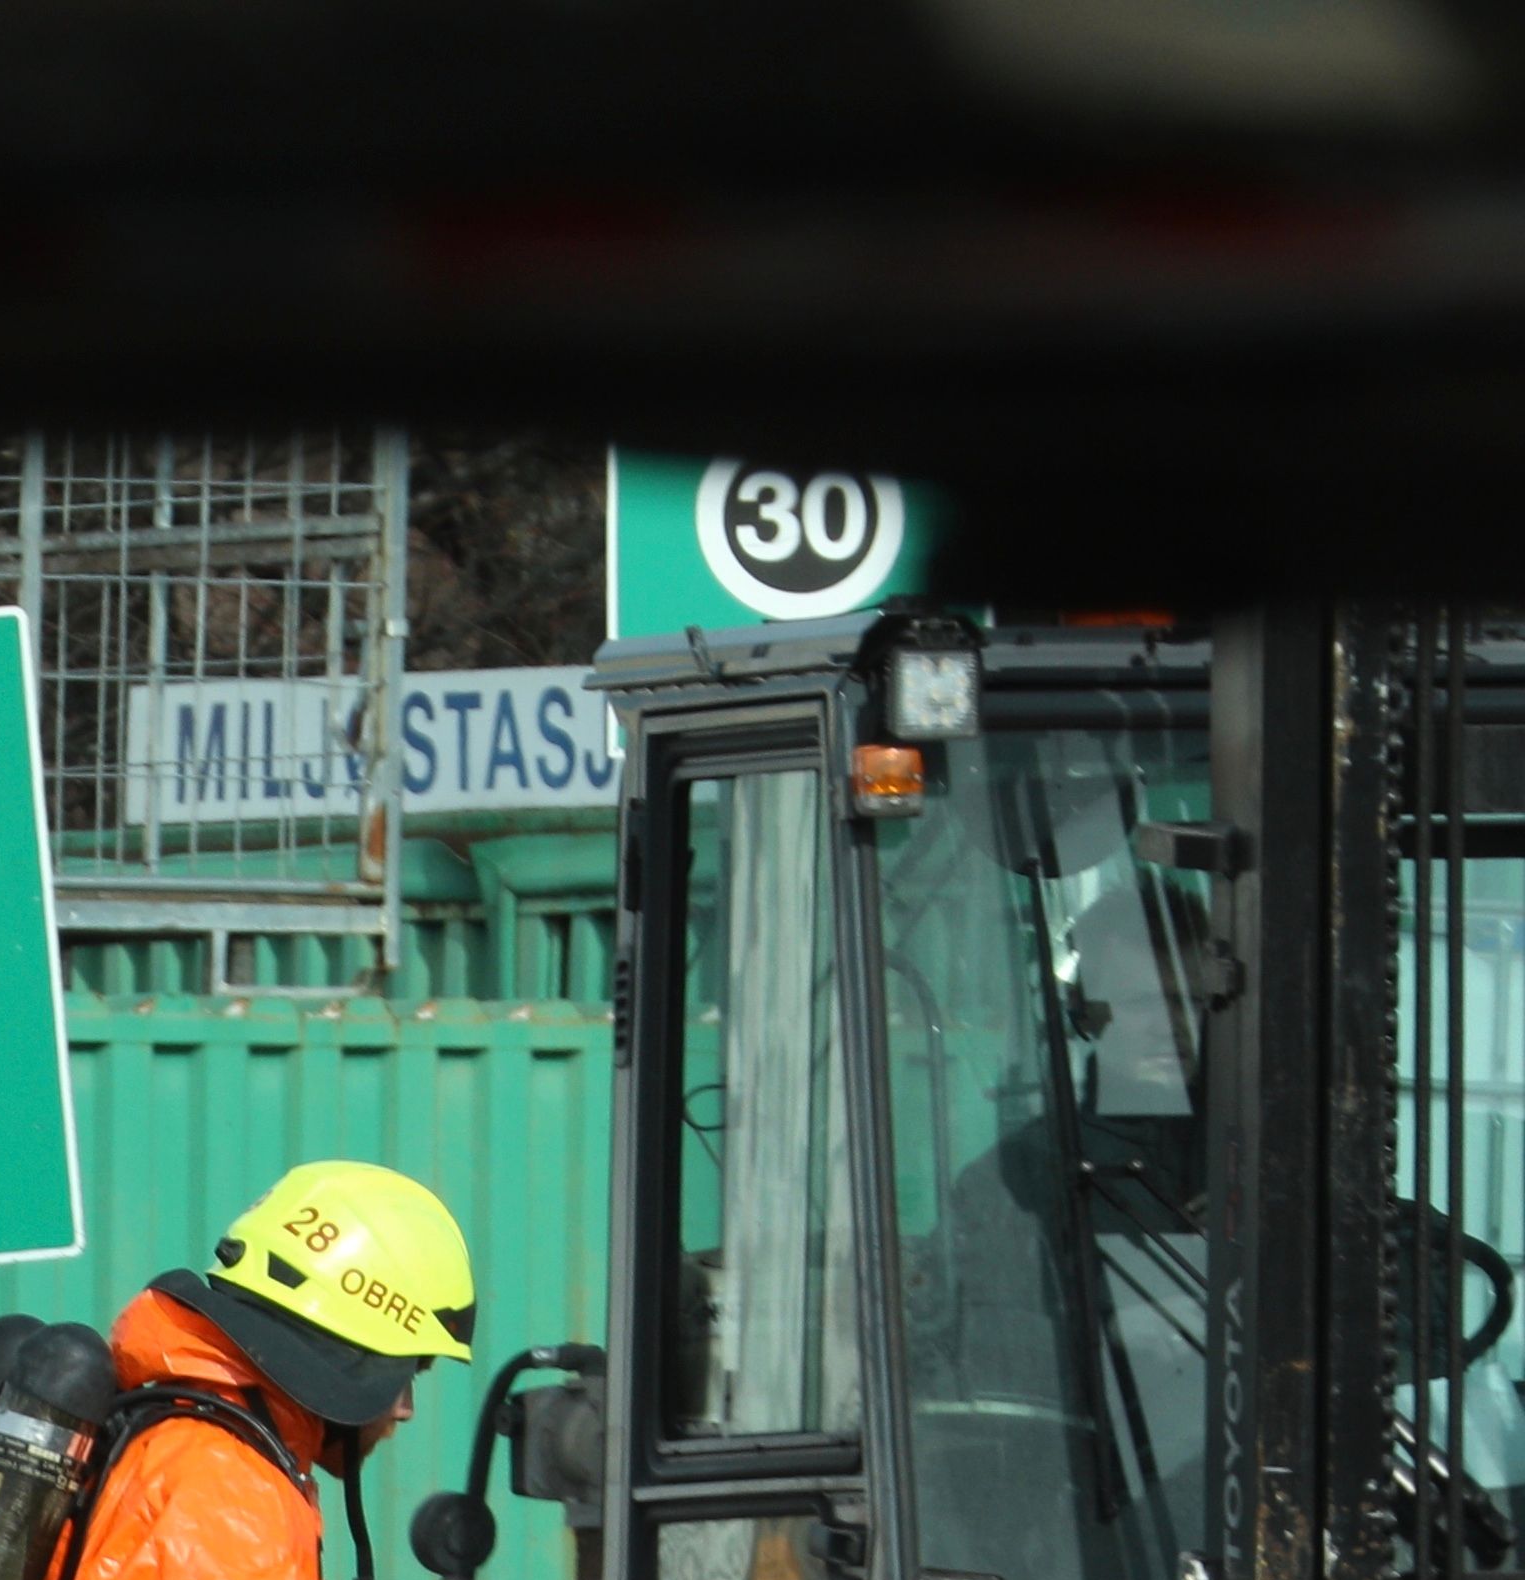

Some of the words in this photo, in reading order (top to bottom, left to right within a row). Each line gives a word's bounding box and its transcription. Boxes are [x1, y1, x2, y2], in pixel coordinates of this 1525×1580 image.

[735, 469, 868, 562] 30
[282, 1206, 340, 1253] 28
[340, 1269, 427, 1335] OBRE
[1223, 1277, 1244, 1570] TOYOTA
